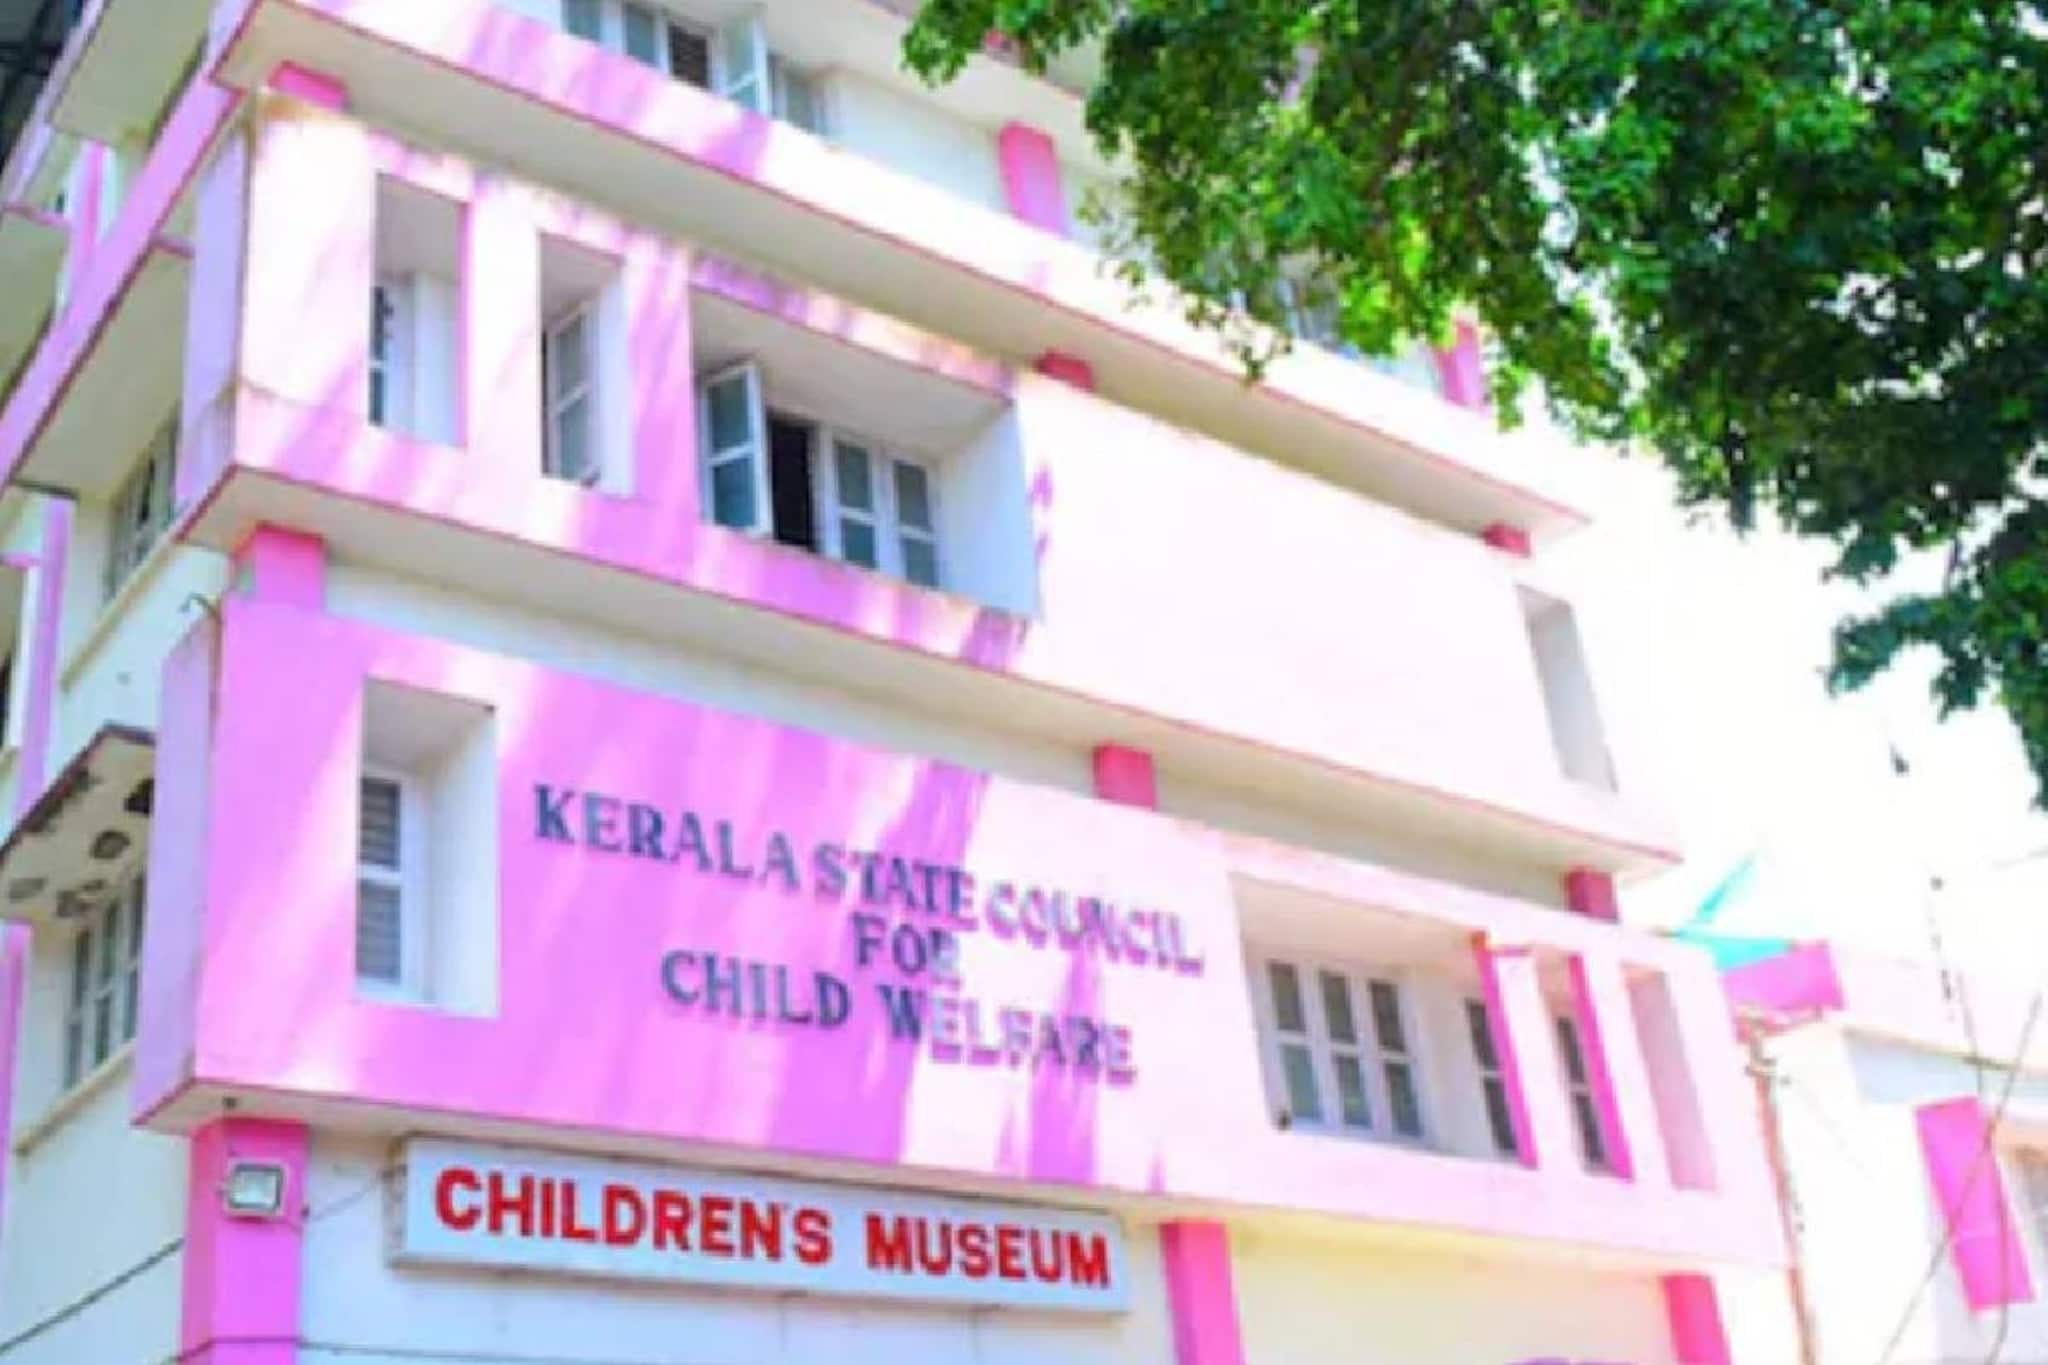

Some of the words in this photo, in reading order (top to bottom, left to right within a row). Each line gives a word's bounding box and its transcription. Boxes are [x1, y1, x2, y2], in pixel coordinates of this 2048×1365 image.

[533, 783, 801, 893] KERALA
[814, 842, 979, 932] STATE
[984, 881, 1205, 977] COUNCIL
[851, 911, 962, 988] FOR
[660, 949, 852, 1029] CHILD
[876, 982, 1137, 1085] WELFARE
[434, 1166, 834, 1266] CHILDREN'S
[865, 1210, 1111, 1289] MUSEUM
